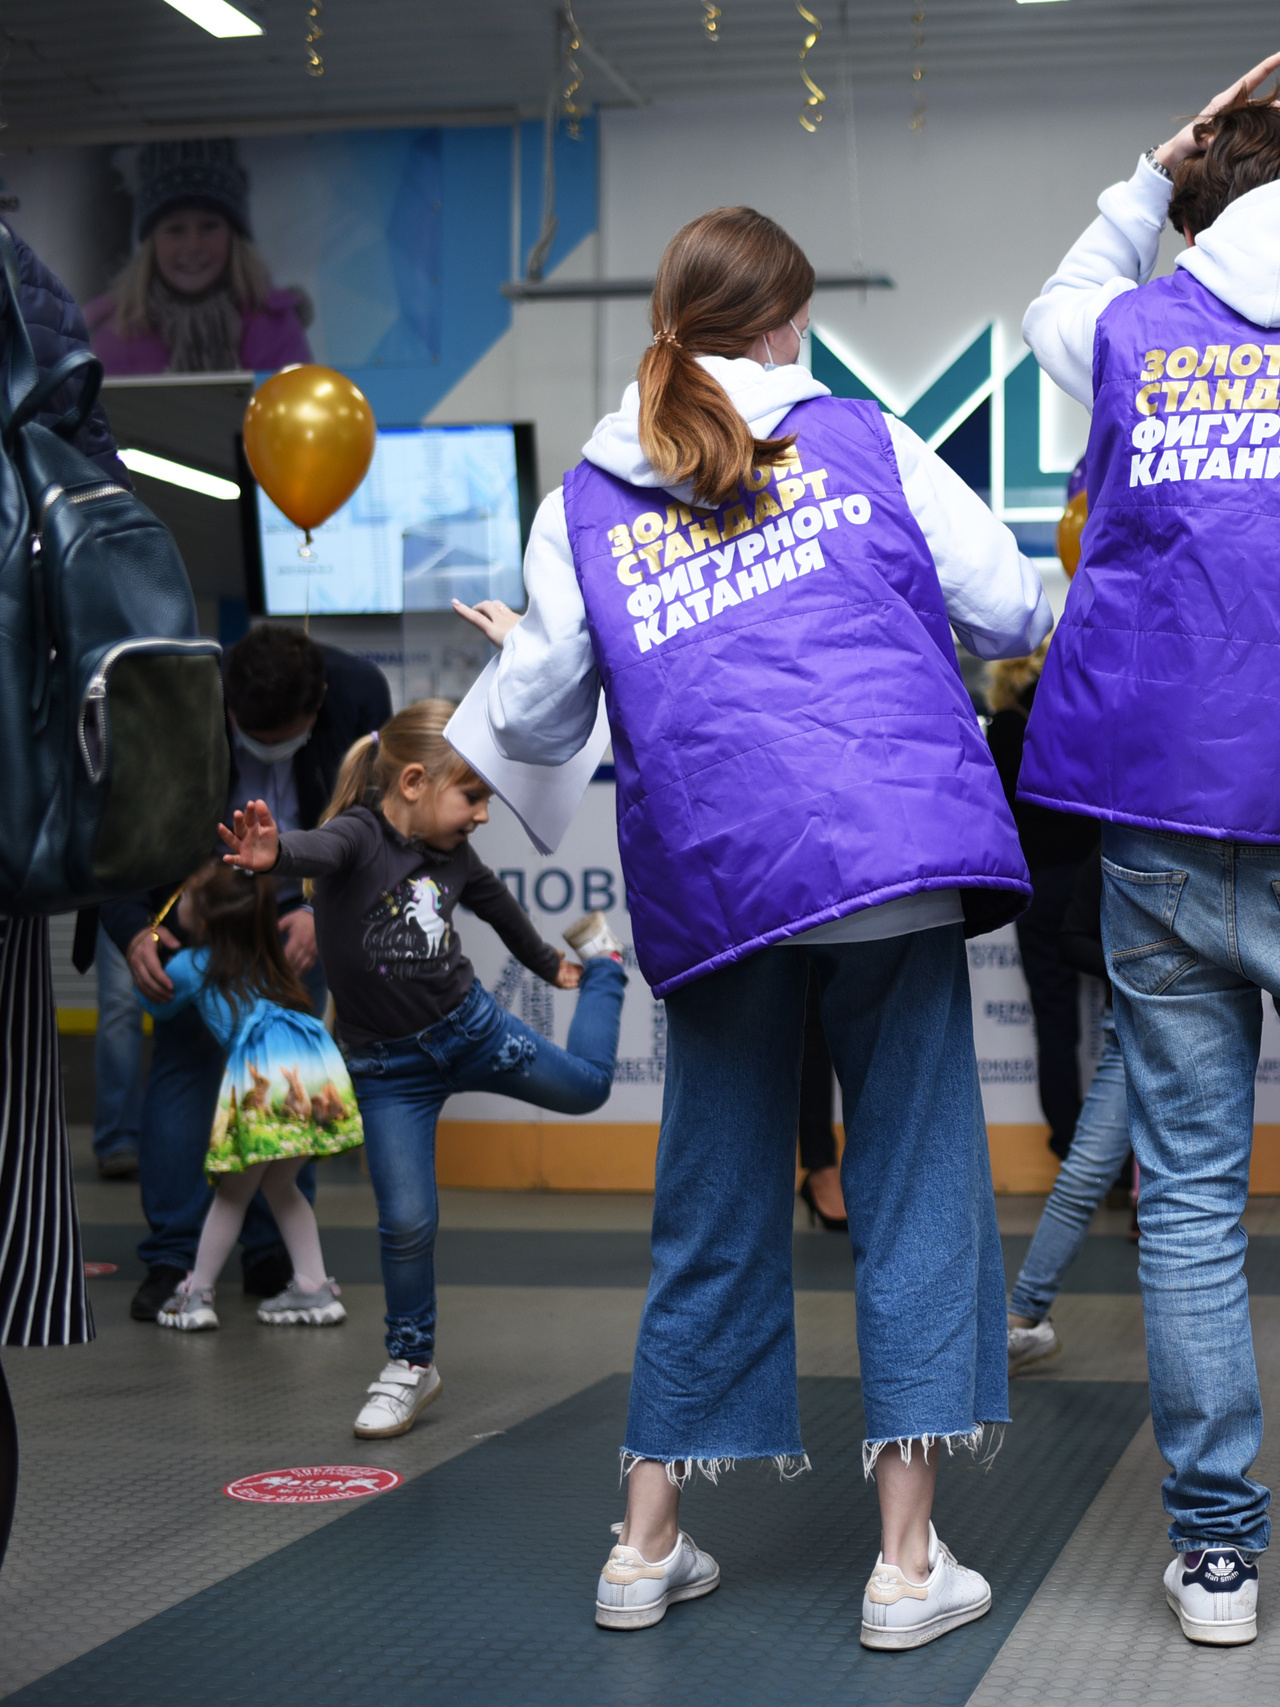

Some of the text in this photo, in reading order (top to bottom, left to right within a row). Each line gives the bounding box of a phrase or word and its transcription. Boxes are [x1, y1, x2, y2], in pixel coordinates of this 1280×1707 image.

[616, 468, 828, 586] СТАНДАРТ
[626, 494, 872, 618] ФИГУРНОГО
[633, 538, 826, 653] КАТАНИЯ
[1204, 1570, 1239, 1582] stan smith
